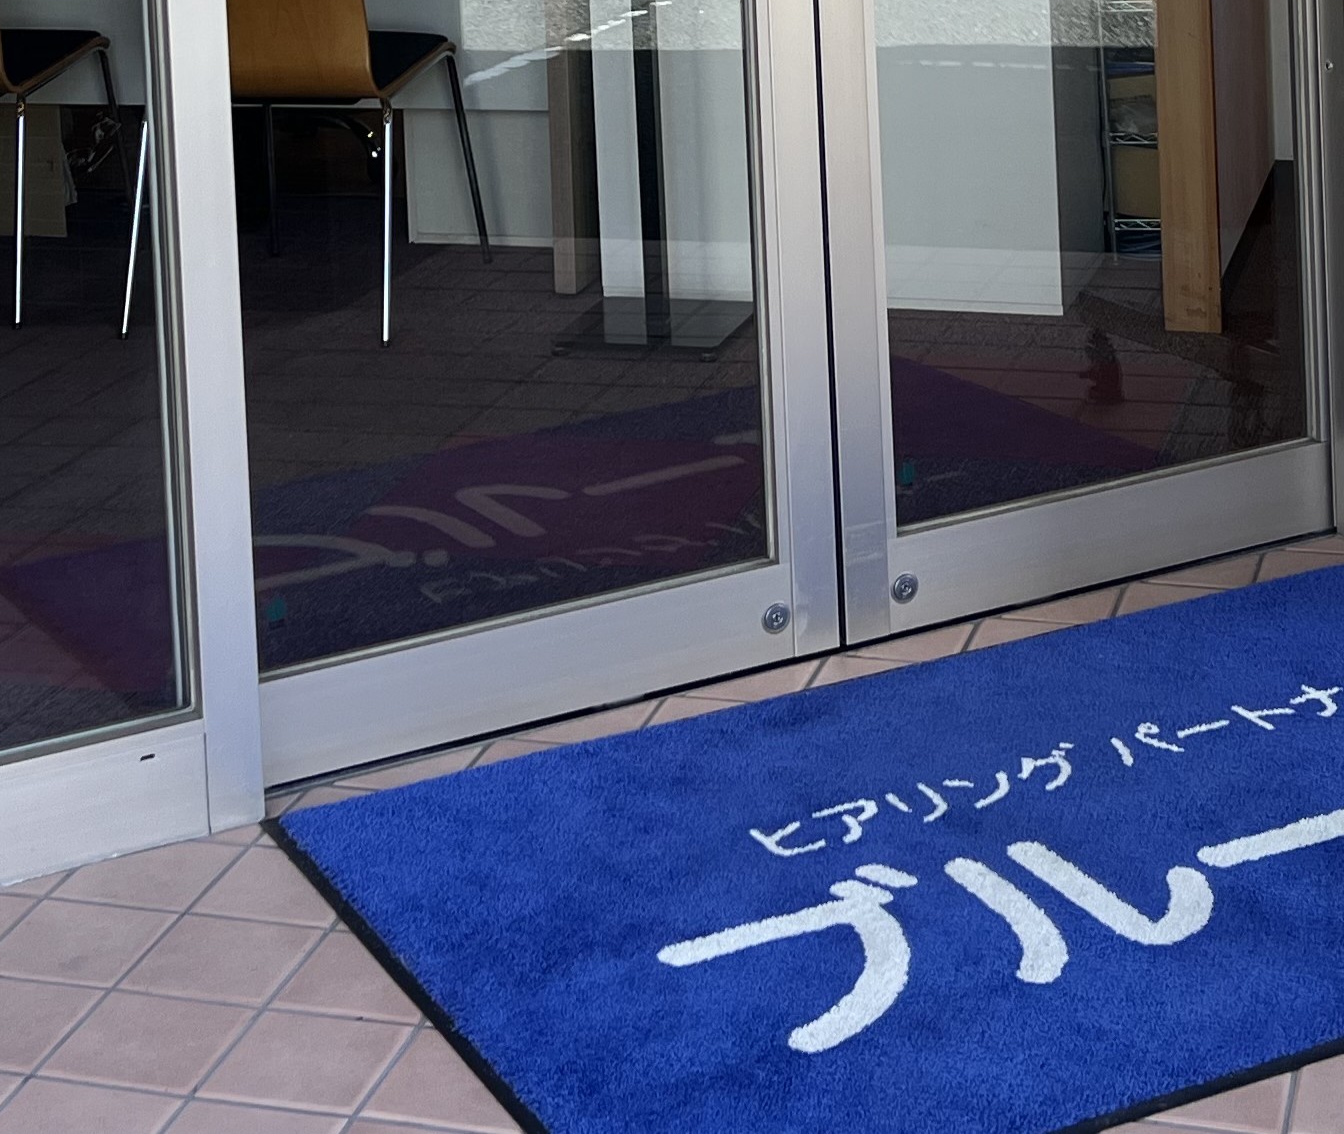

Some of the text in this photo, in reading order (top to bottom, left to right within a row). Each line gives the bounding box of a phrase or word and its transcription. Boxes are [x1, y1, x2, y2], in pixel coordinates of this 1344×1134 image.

[749, 742, 1074, 855] ヒアリング
